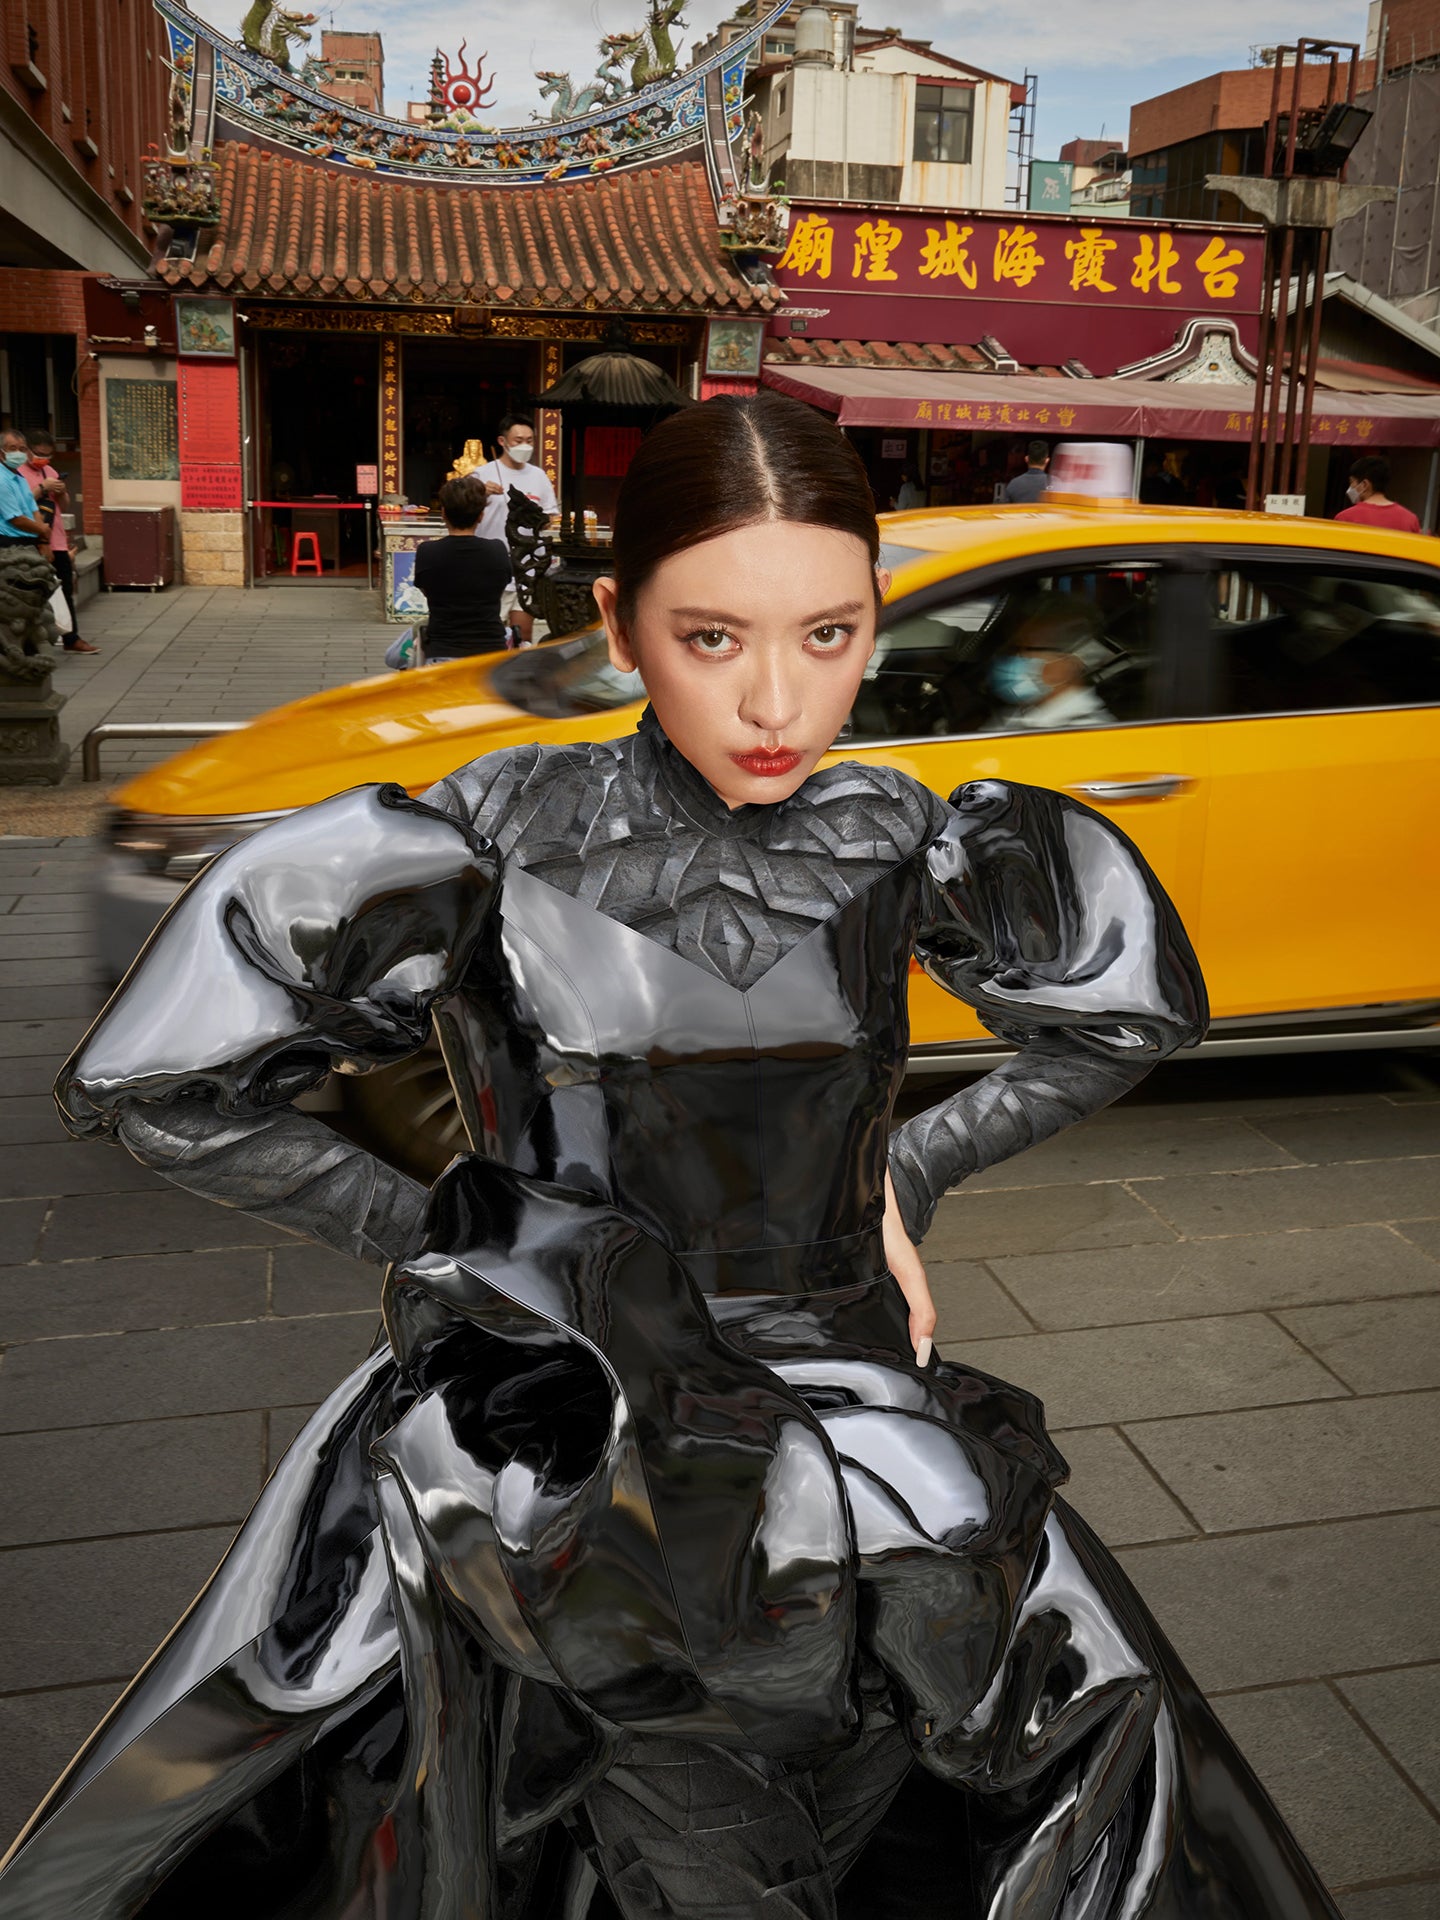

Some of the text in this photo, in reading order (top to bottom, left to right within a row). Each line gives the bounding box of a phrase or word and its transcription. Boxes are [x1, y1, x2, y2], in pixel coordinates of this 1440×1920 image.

[776, 213, 1246, 298] 台北霞海城隍廟
